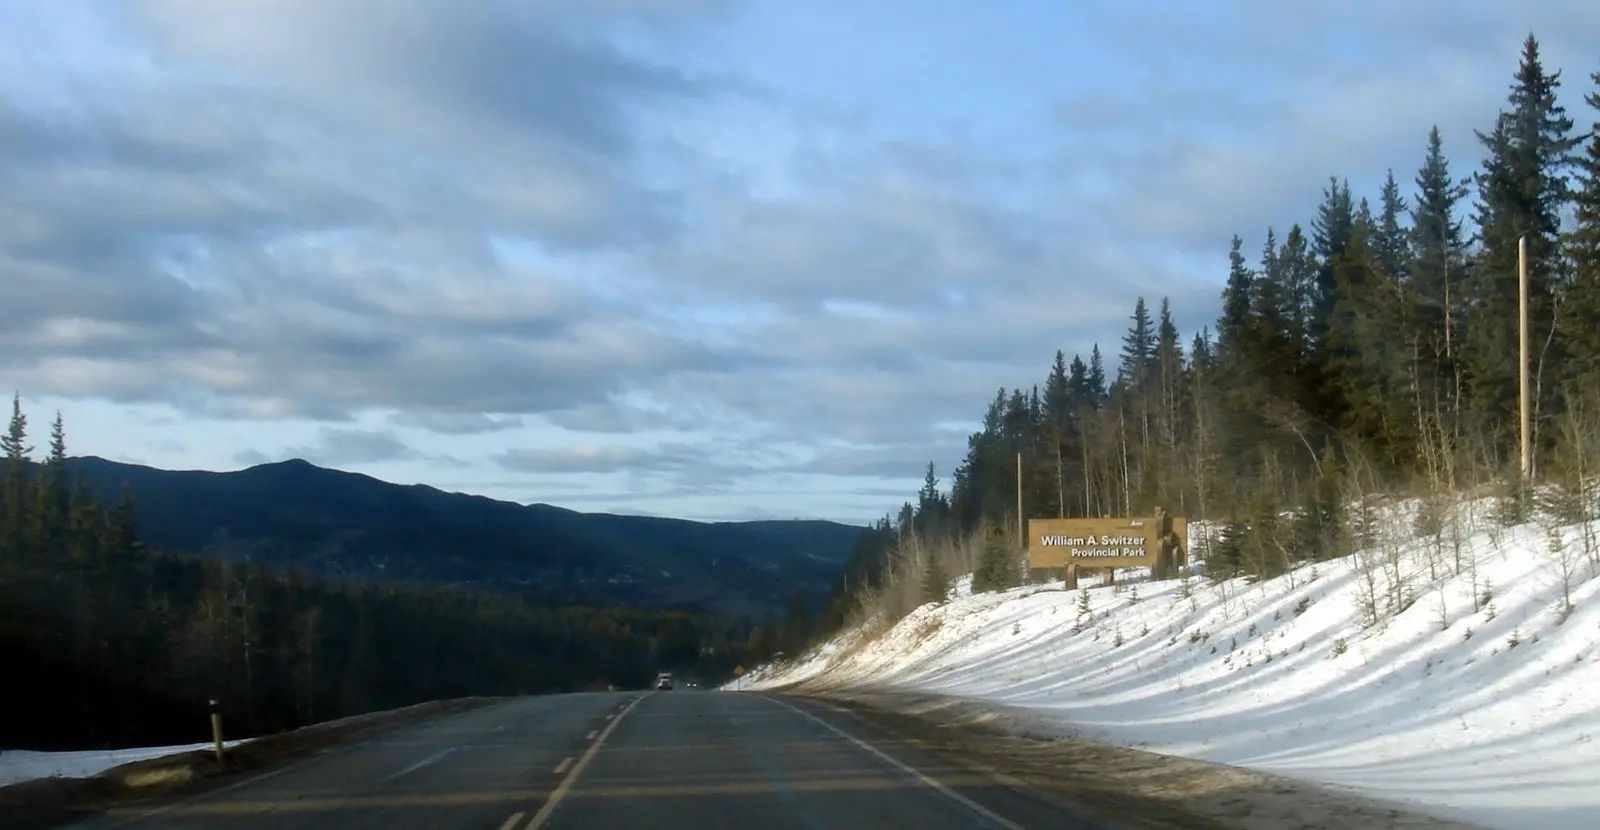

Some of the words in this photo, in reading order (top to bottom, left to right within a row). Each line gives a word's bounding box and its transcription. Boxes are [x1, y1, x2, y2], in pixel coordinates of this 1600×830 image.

[1041, 535, 1084, 546] William
[1087, 535, 1098, 546] A.
[1101, 535, 1145, 546] Switzer
[1071, 547, 1119, 557] Provincial
[1123, 547, 1145, 557] Park
